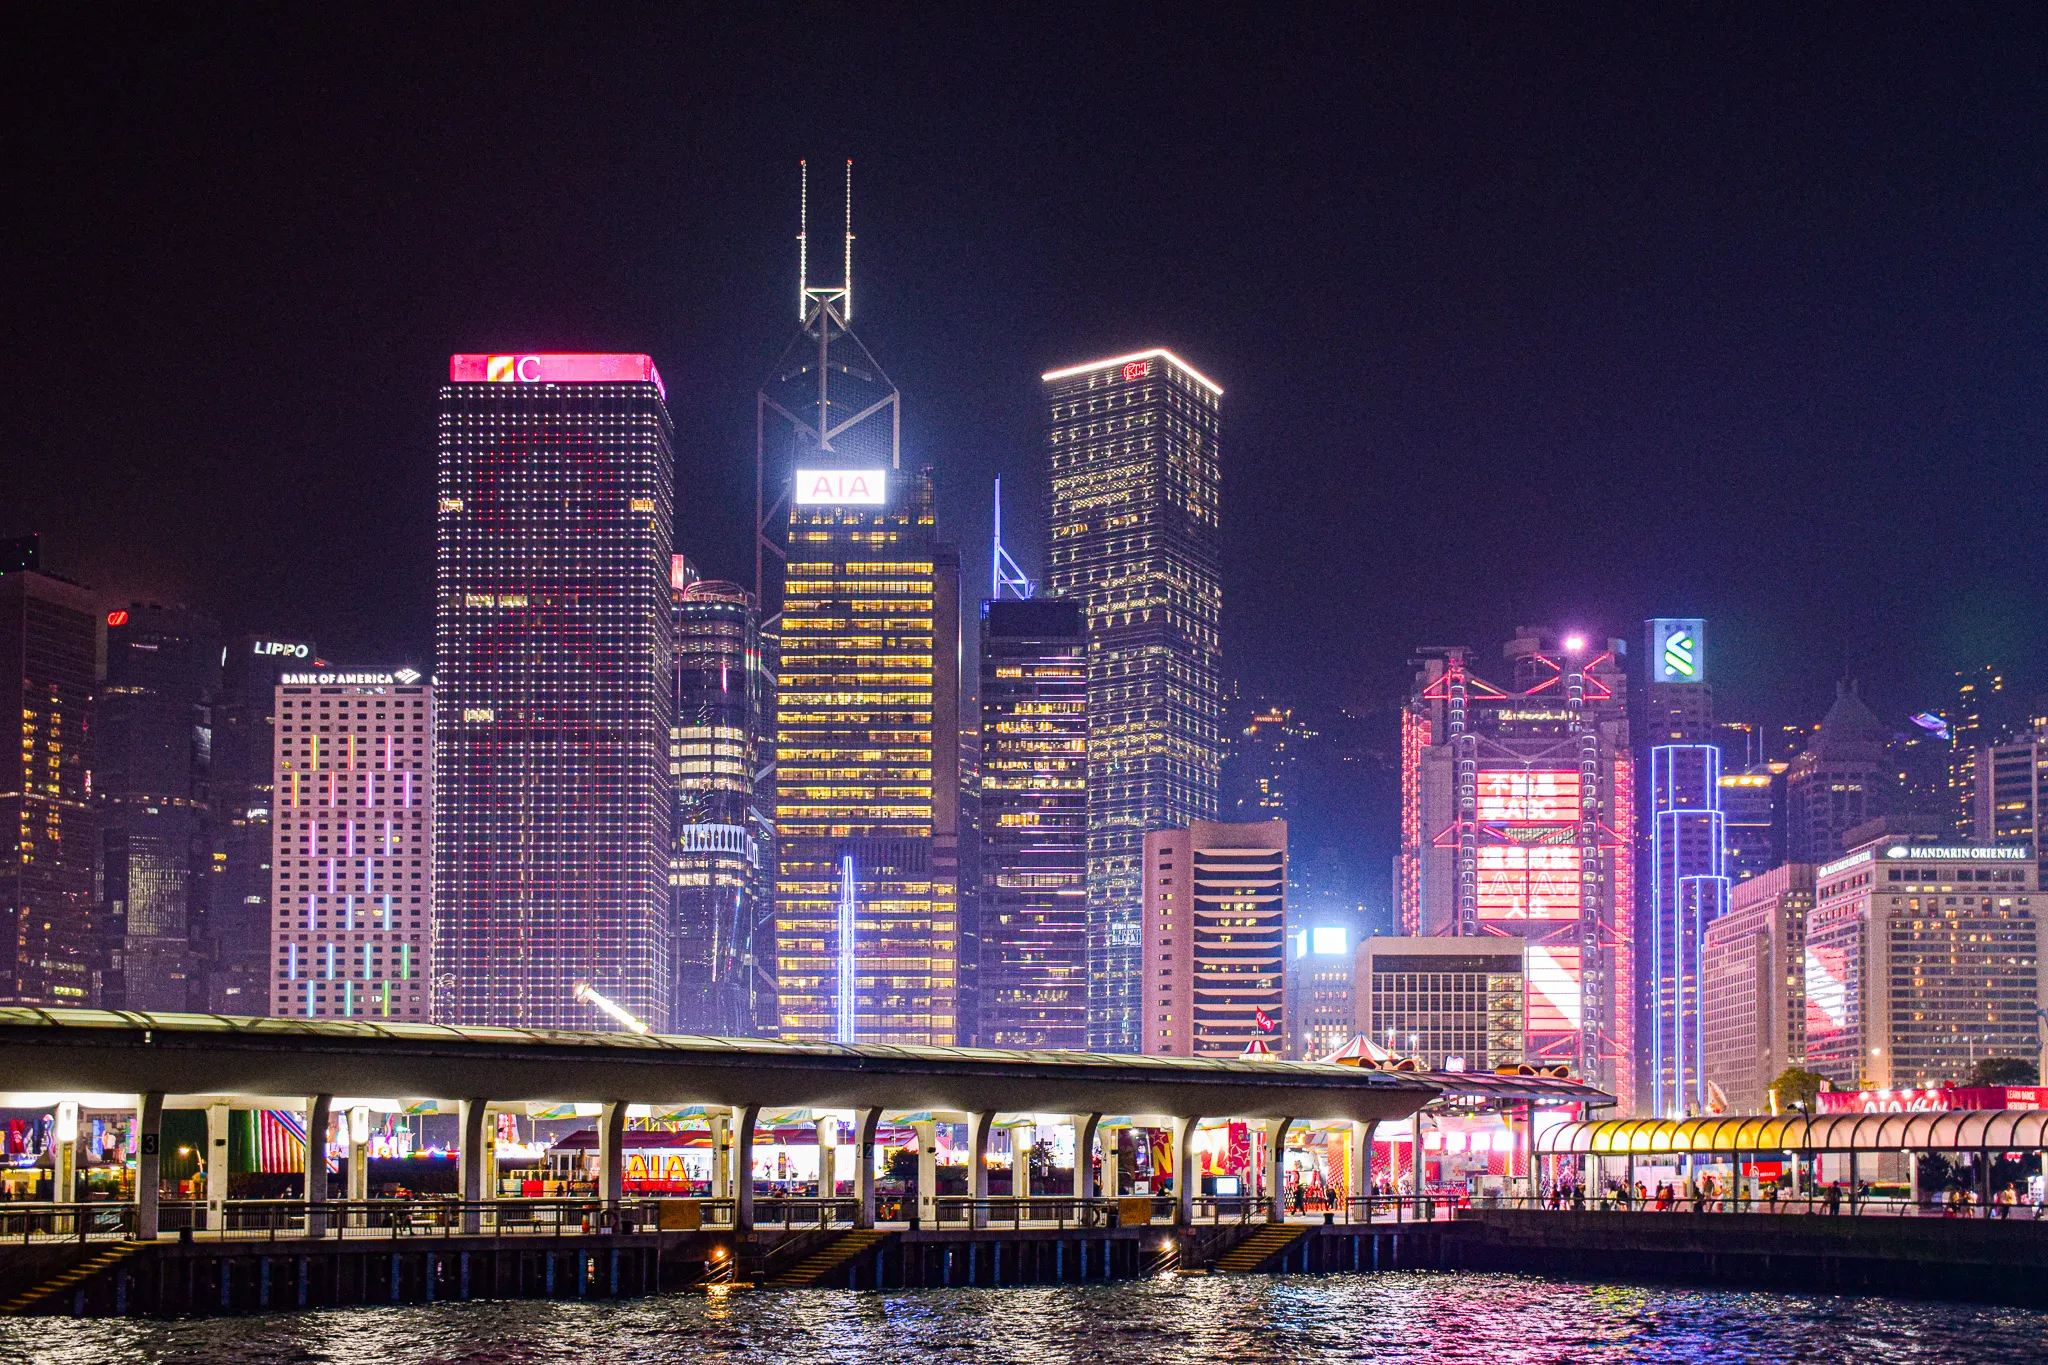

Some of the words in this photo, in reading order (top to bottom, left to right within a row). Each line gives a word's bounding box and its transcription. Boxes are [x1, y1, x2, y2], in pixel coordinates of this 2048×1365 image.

[812, 476, 870, 497] AIA
[254, 641, 309, 658] LIPPO
[282, 674, 318, 684] BANK
[320, 674, 336, 684] OF
[337, 674, 394, 684] AMERICA
[1911, 848, 1970, 859] MANDARIN
[1971, 848, 2026, 859] ORIENTAL
[1504, 897, 1550, 919] 人生
[1257, 1011, 1271, 1029] AIA
[145, 1135, 155, 1153] 3
[865, 1143, 873, 1158] 2
[627, 1154, 688, 1182] AIA
